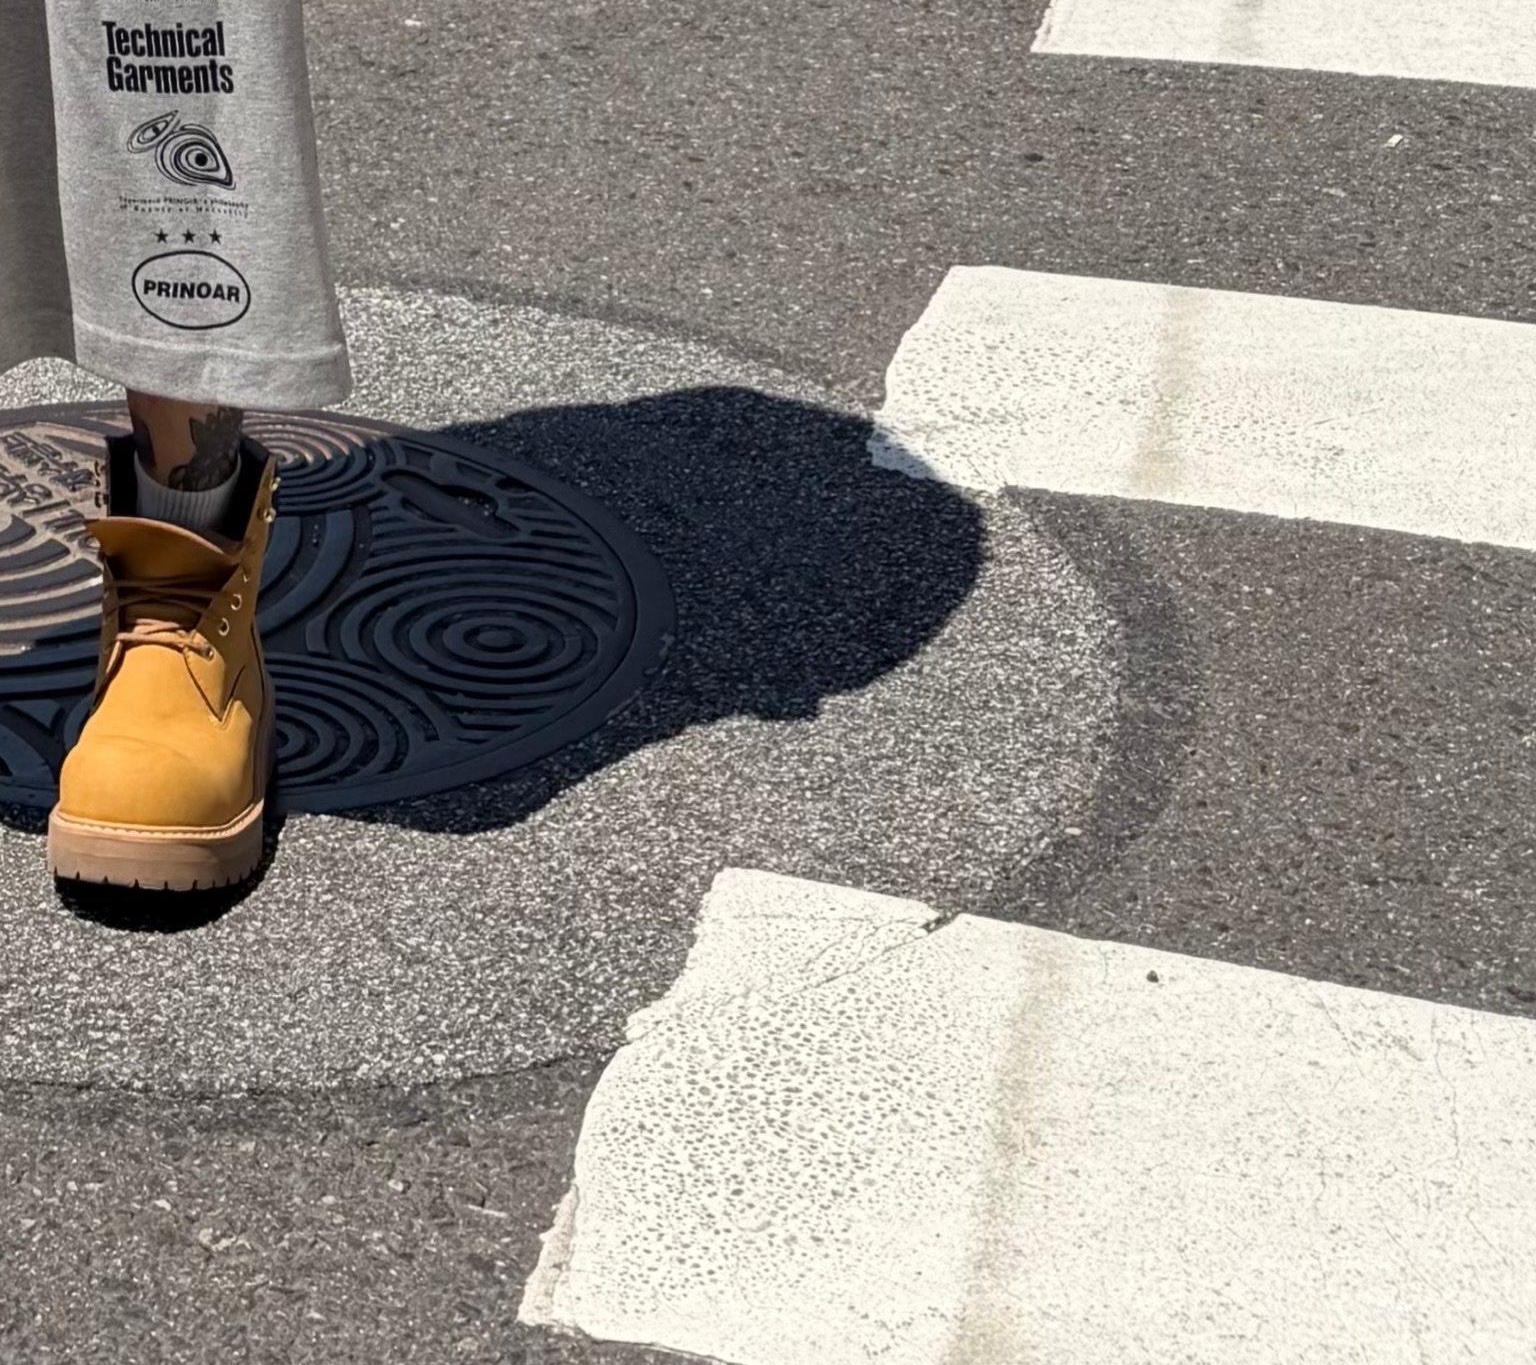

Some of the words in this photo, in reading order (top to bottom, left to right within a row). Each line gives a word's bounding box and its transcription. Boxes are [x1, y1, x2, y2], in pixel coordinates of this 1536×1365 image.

[102, 20, 226, 58] Technical
[106, 55, 235, 94] Garments
[143, 279, 241, 304] PRINOAR
